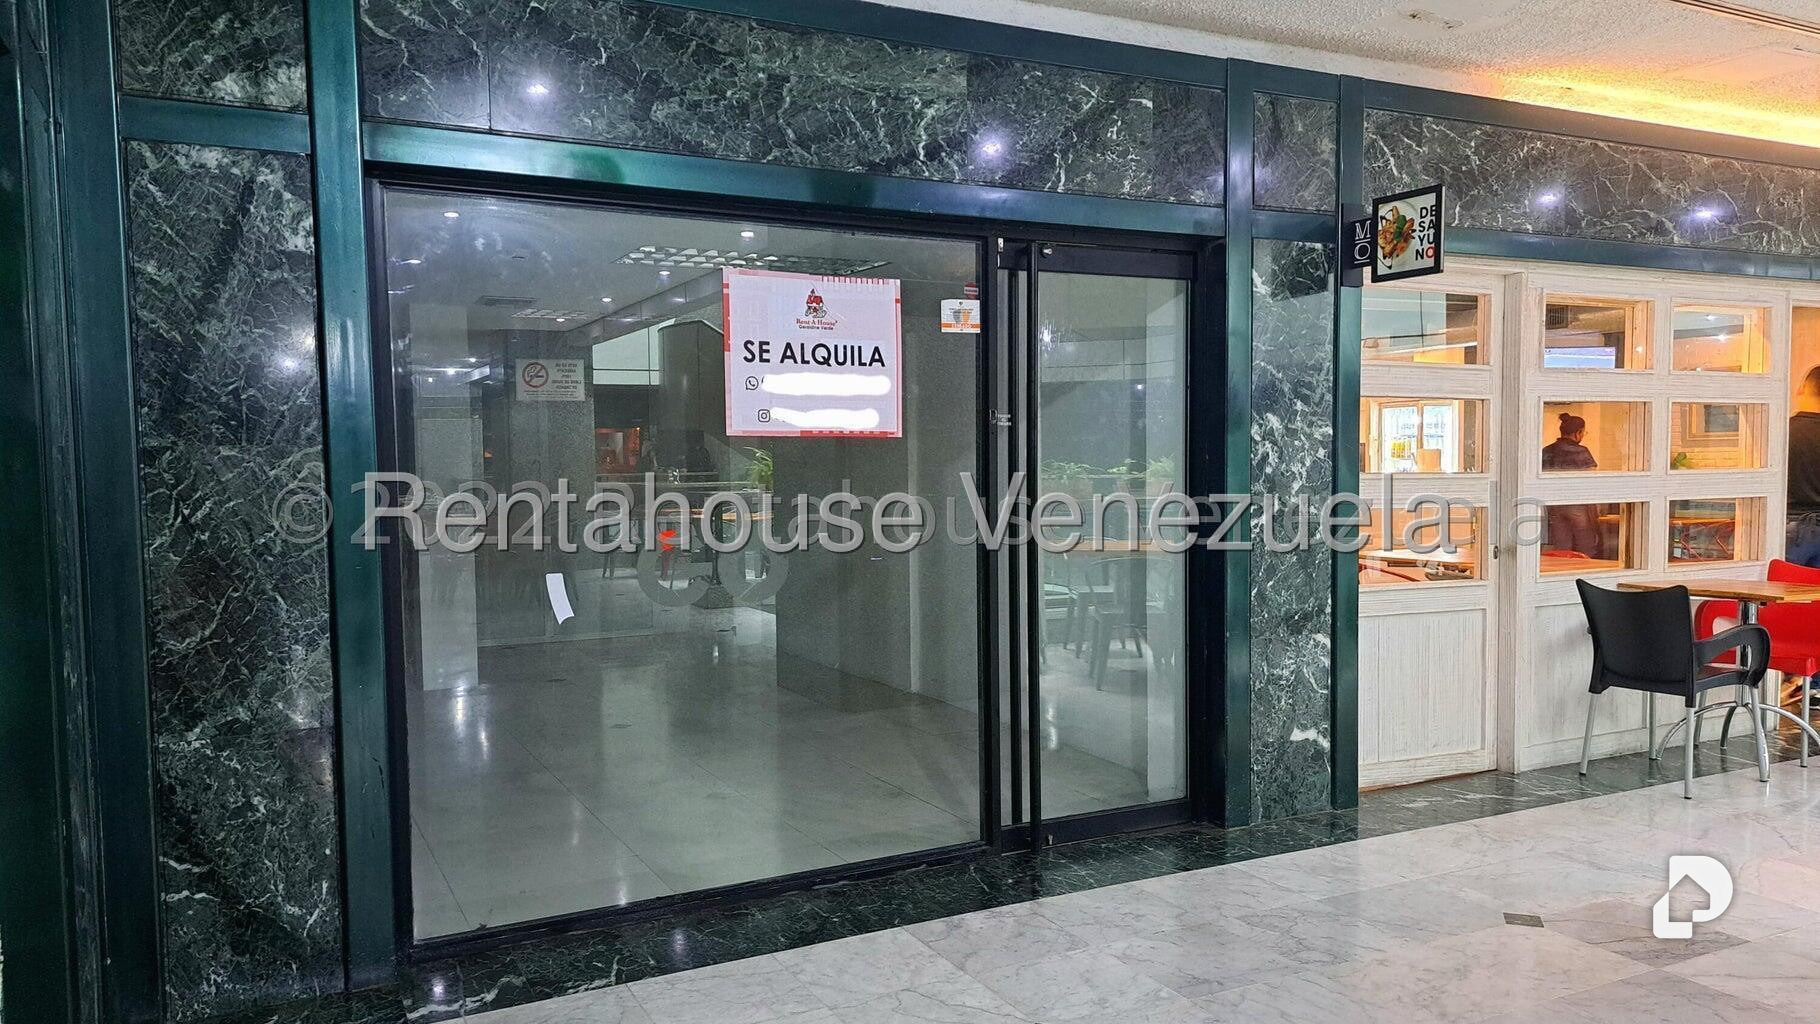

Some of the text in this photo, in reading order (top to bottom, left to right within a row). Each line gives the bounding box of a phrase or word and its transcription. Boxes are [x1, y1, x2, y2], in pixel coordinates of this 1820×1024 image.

[1418, 219, 1436, 233] SA
[1417, 232, 1435, 247] YU
[1415, 246, 1436, 261] NO
[743, 339, 886, 367] SE ALQUILA
